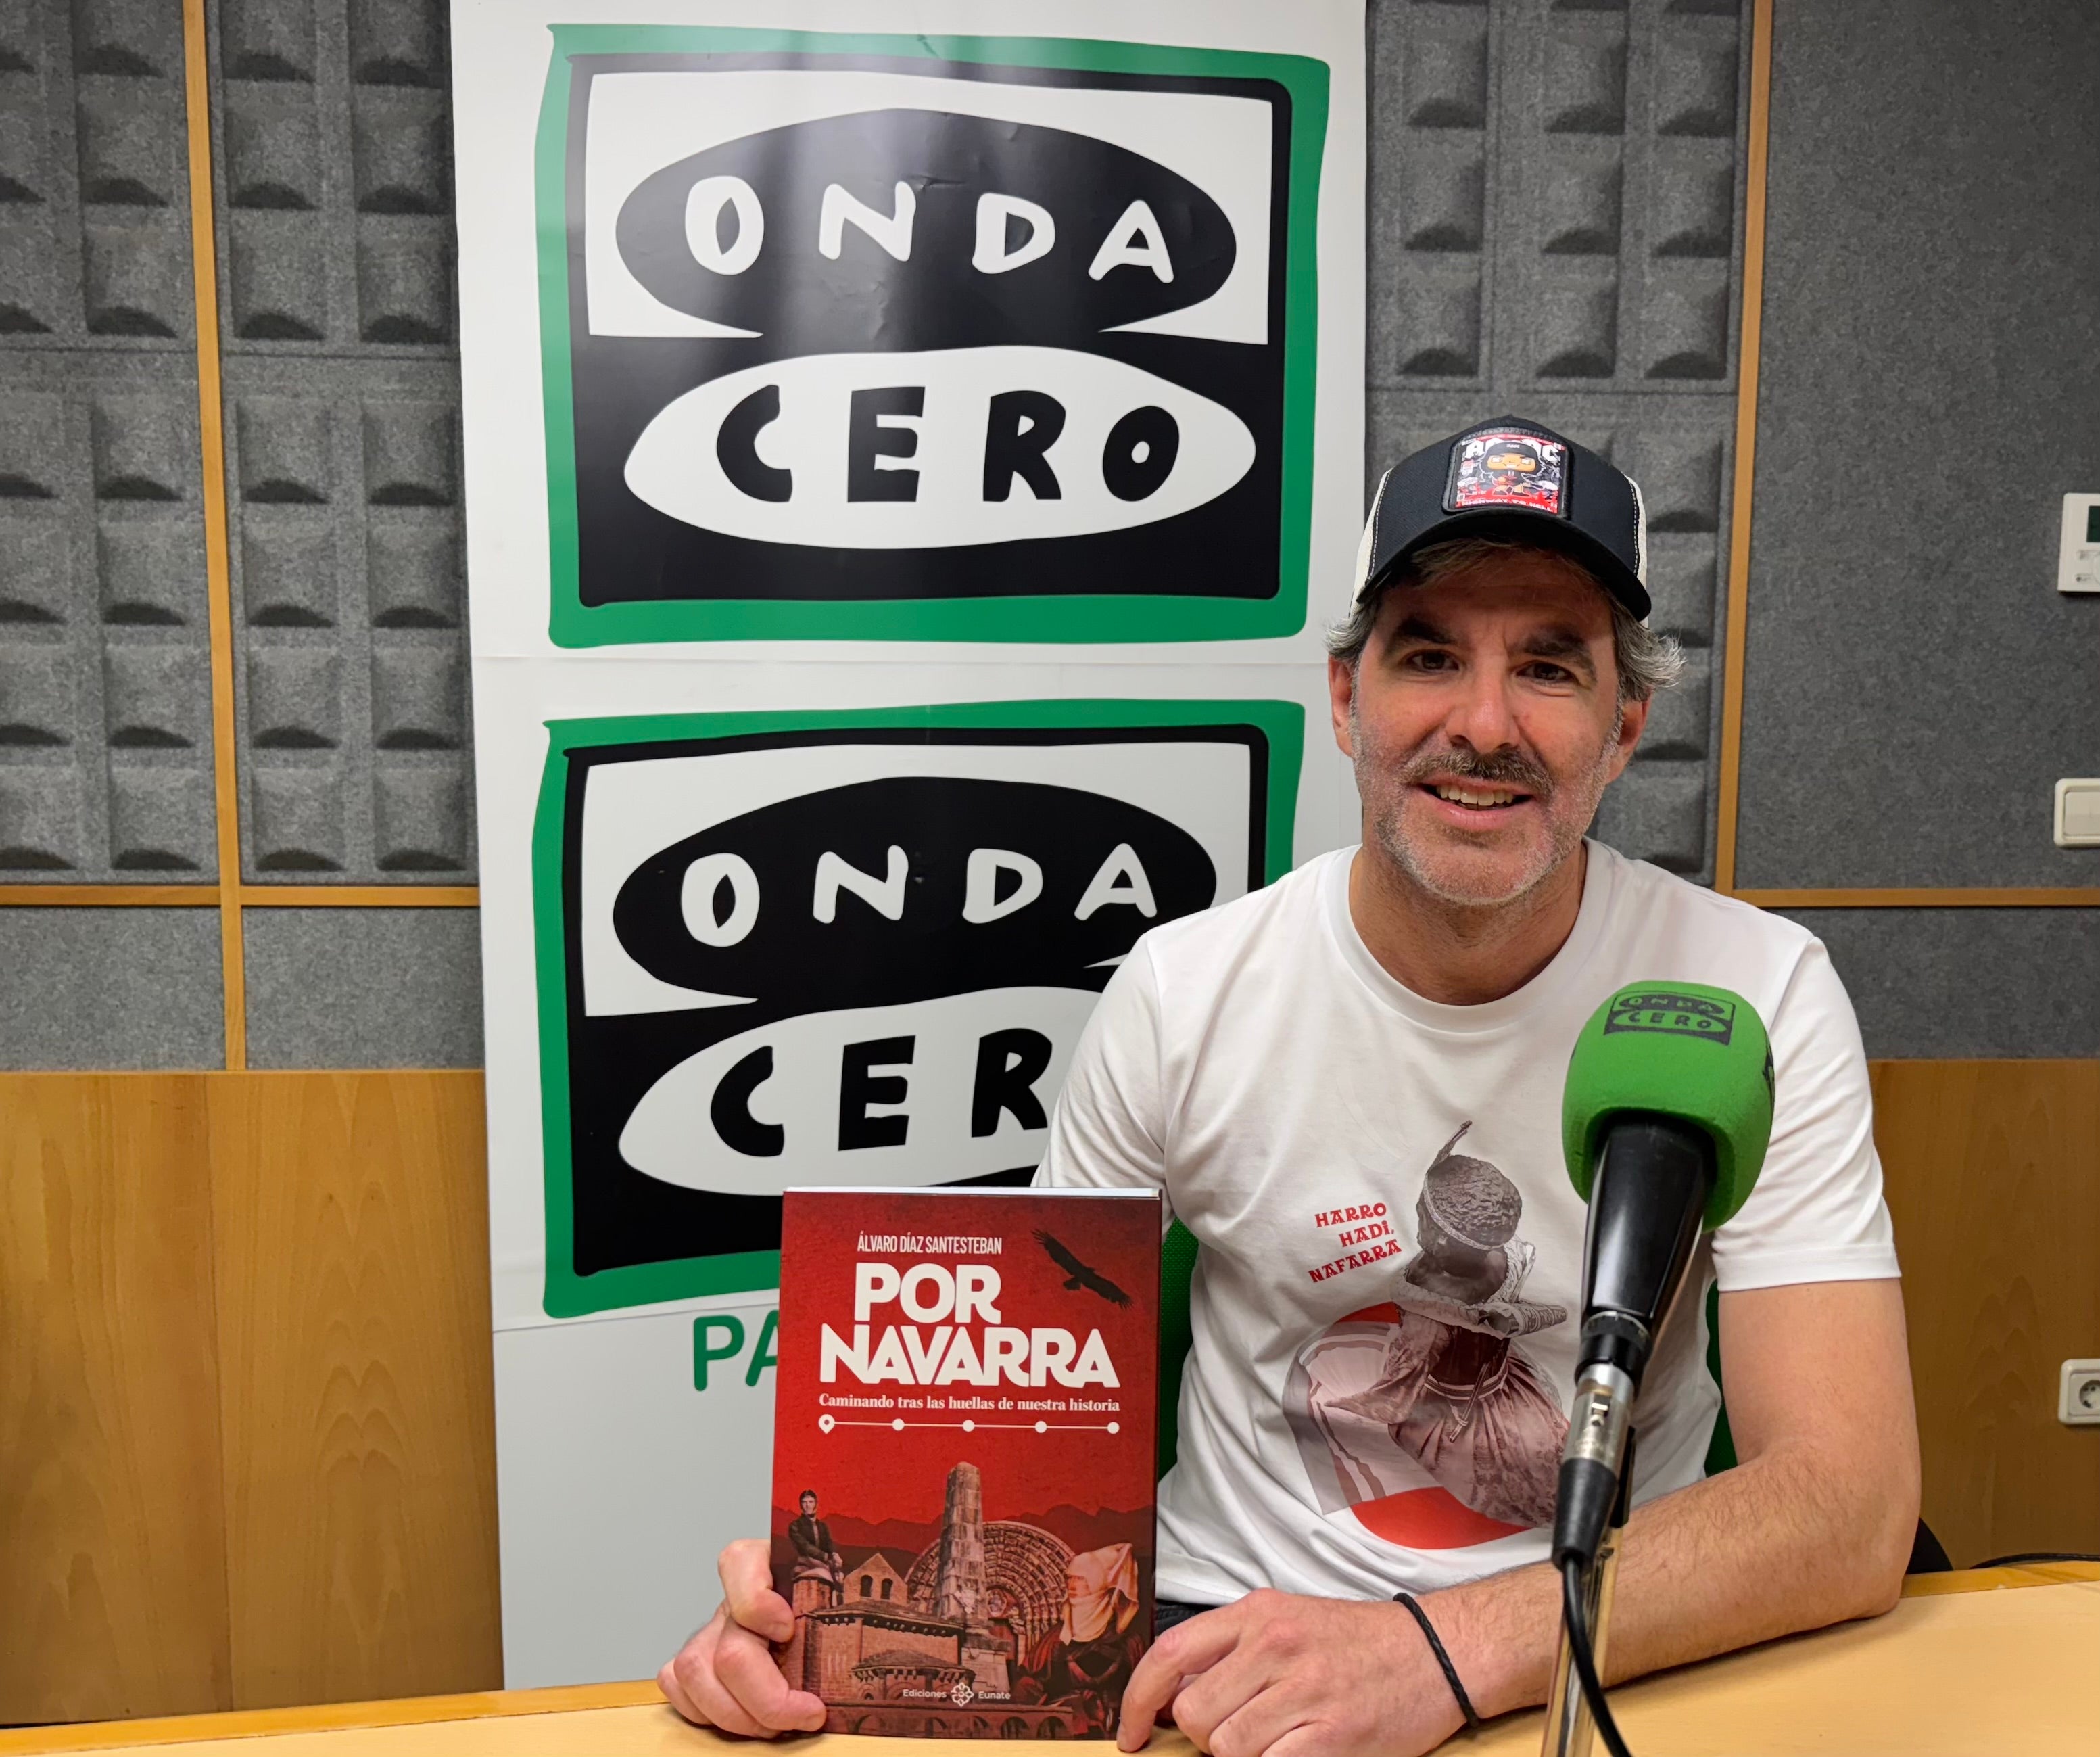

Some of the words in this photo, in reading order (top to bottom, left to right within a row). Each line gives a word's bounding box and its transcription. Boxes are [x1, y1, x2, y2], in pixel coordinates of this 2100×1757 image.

[685, 174, 1174, 283] ONDA
[716, 384, 1180, 502] CERO
[681, 843, 1157, 947] ONDA
[1628, 997, 1713, 1012] ONDA
[1628, 1012, 1712, 1029] CERO
[710, 1027, 1053, 1158] CER
[1314, 1202, 1387, 1228] HARRO
[857, 1230, 898, 1252] ÁLVARO
[899, 1232, 924, 1253] DÍAZ
[925, 1236, 1002, 1255] SANTESTEBAN
[1308, 1238, 1402, 1283] NAFARRA
[854, 1262, 1002, 1325] POR
[819, 1323, 1120, 1388] NAVARRA
[819, 1392, 894, 1408] Caminando
[897, 1397, 924, 1409] tras
[926, 1395, 945, 1409] las
[948, 1395, 995, 1409] huellas
[998, 1397, 1014, 1410] de
[1017, 1399, 1066, 1411] nuestra
[1069, 1398, 1120, 1412] historia
[903, 1689, 947, 1698] Ediciones
[978, 1691, 1011, 1700] Eunate
